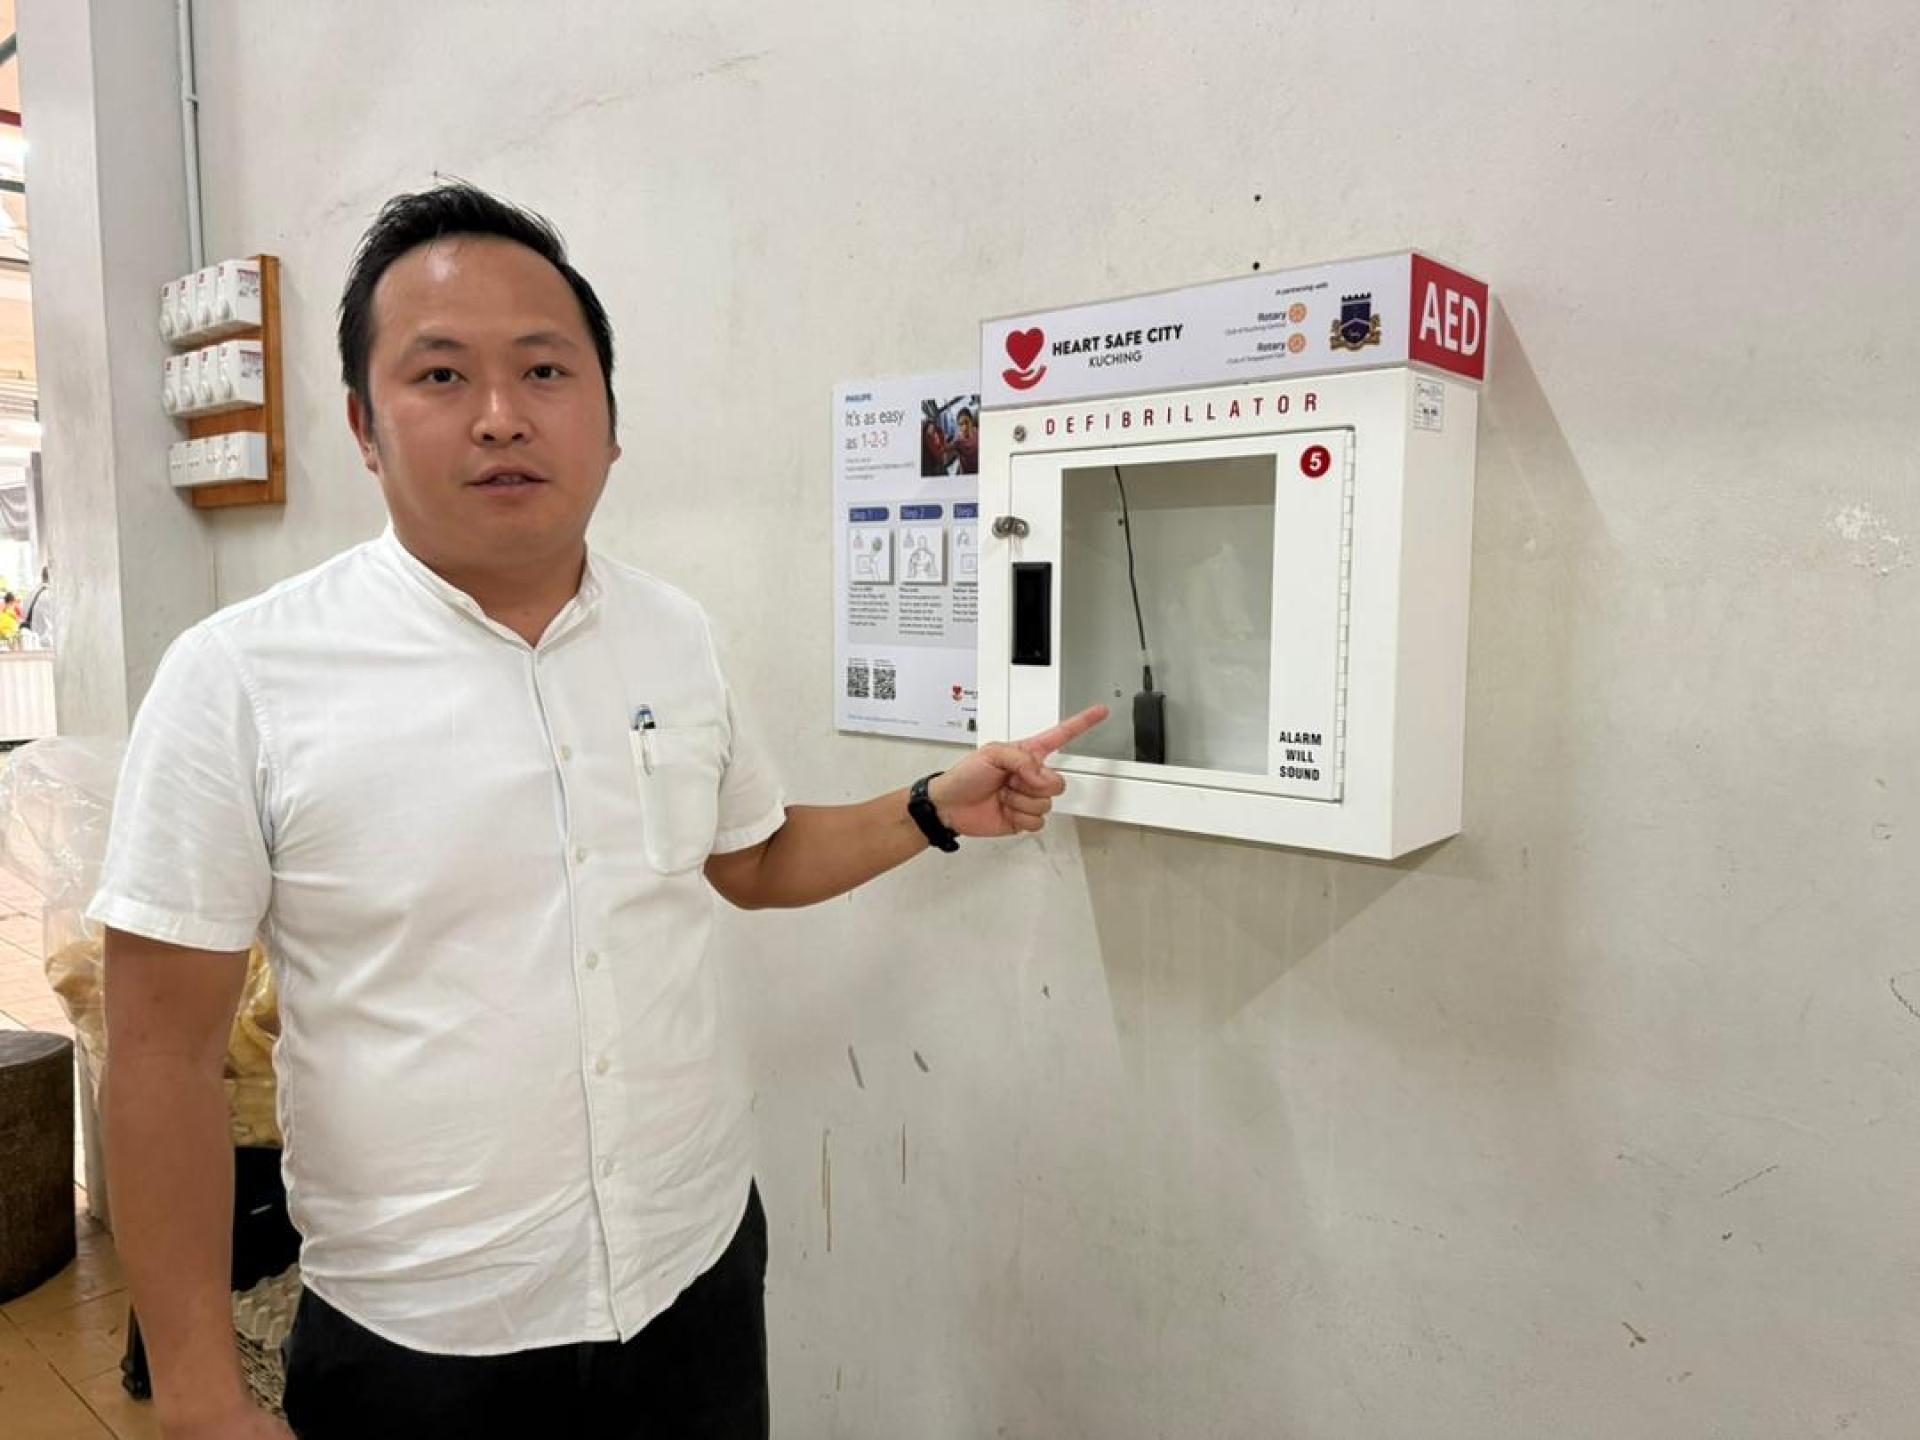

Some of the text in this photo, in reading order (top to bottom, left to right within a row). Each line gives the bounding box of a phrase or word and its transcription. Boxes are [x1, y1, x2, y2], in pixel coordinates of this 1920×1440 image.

[1257, 311, 1286, 322] Rotary
[1418, 281, 1480, 356] AED
[1052, 324, 1183, 356] HEART SAFE CITY
[1257, 342, 1285, 352] Rotary
[1088, 350, 1143, 368] KUCHING
[863, 412, 876, 426] as
[880, 409, 905, 426] easy
[1045, 393, 1318, 435] DEFIBRILLATOR
[845, 438, 858, 450] as
[1309, 451, 1322, 471] 5
[1279, 731, 1322, 746] ALARM
[1286, 750, 1314, 763] WILL
[1279, 765, 1320, 781] SOUND
